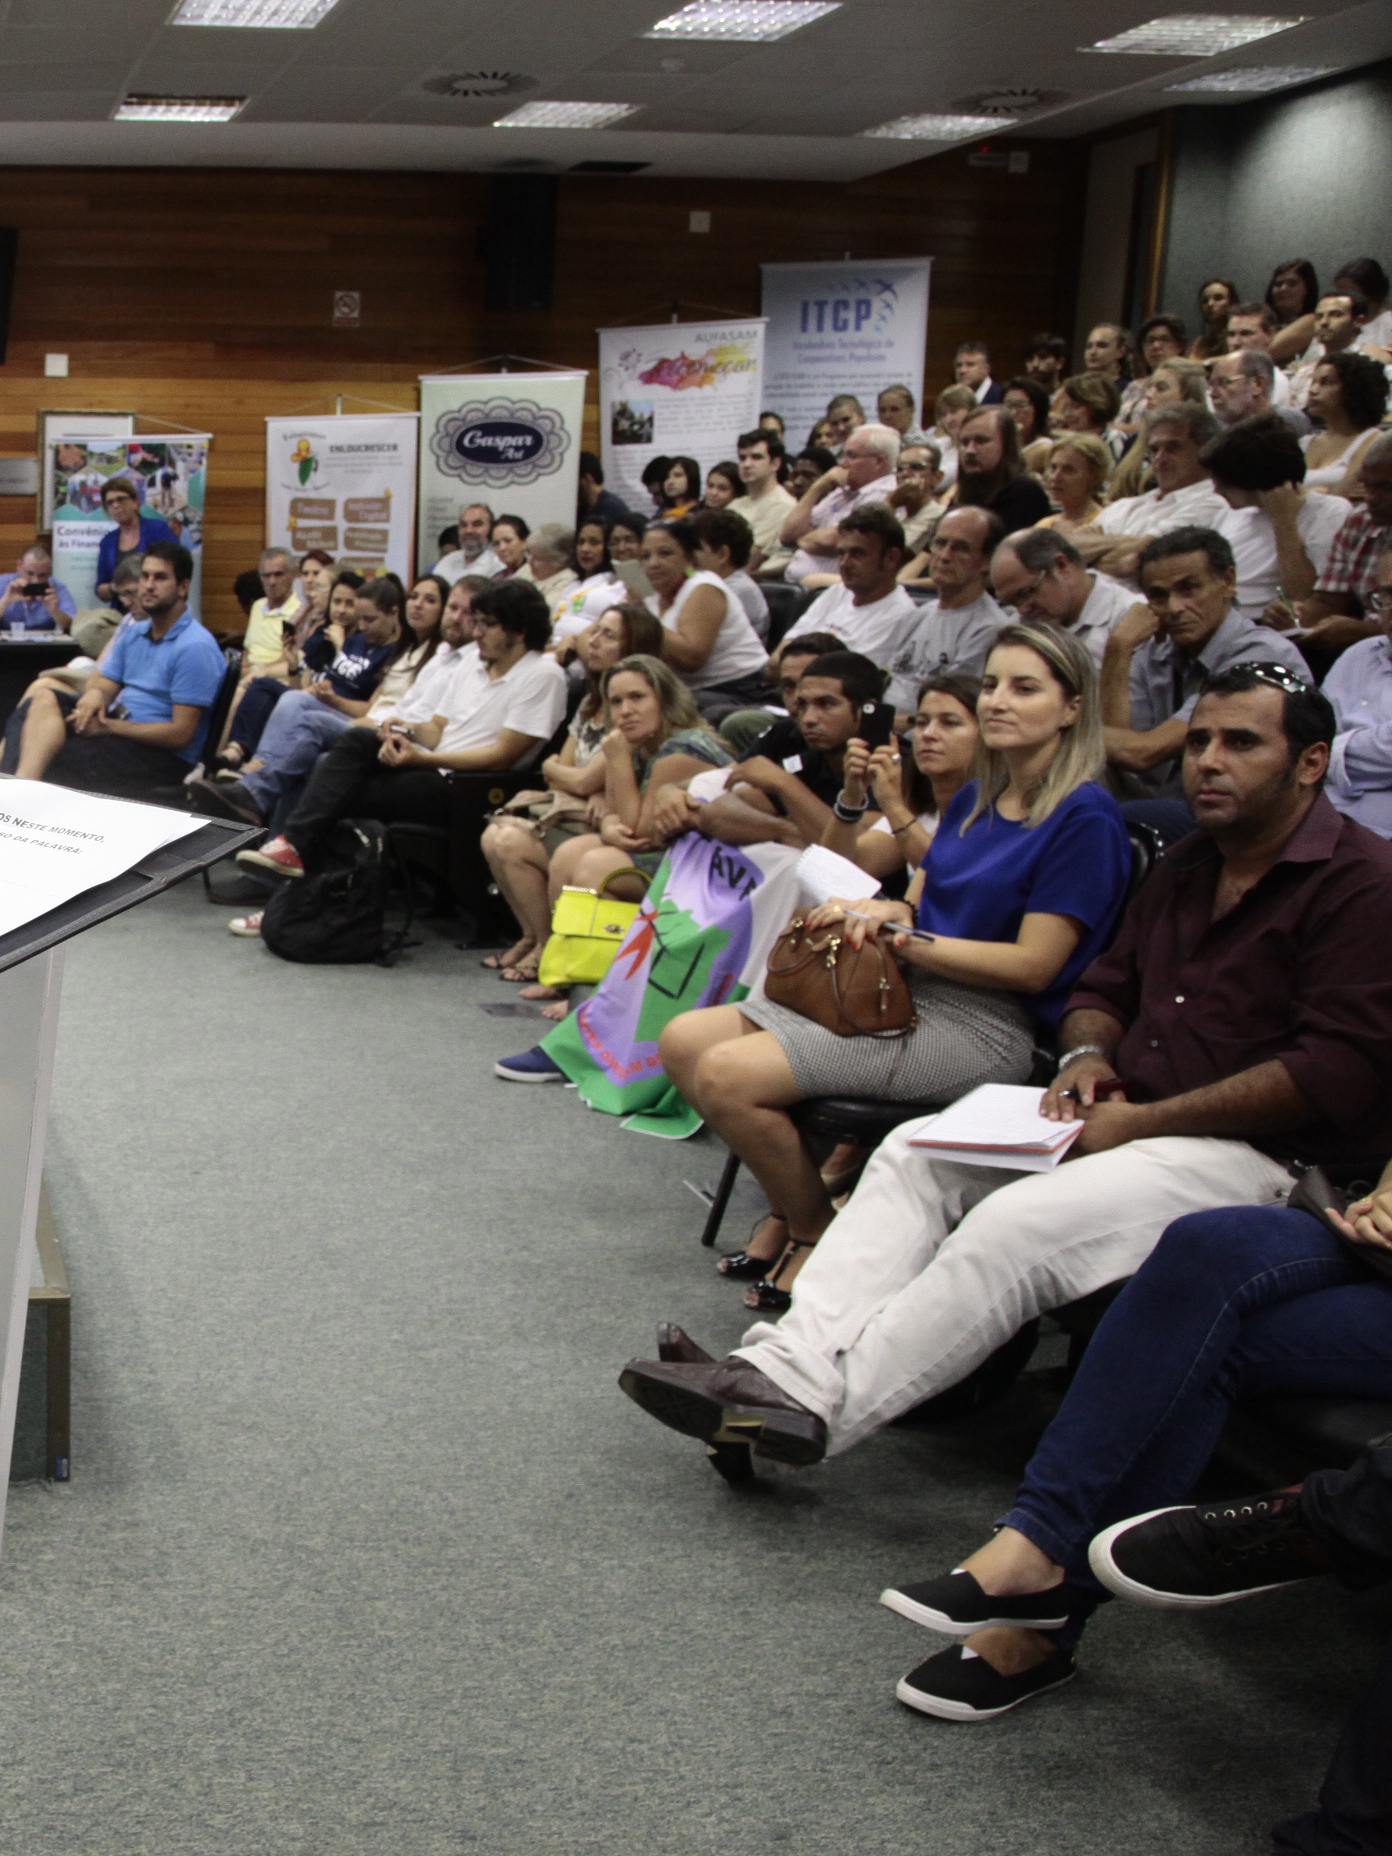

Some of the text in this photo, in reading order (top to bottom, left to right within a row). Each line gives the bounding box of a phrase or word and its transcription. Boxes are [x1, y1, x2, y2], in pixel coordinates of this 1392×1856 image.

[800, 299, 872, 333] ITCP
[462, 429, 535, 452] Gaspar
[12, 817, 47, 832] NESTE
[48, 826, 105, 844] MOMENTO,
[13, 835, 29, 844] DA
[30, 839, 84, 855] PALAVRA:
